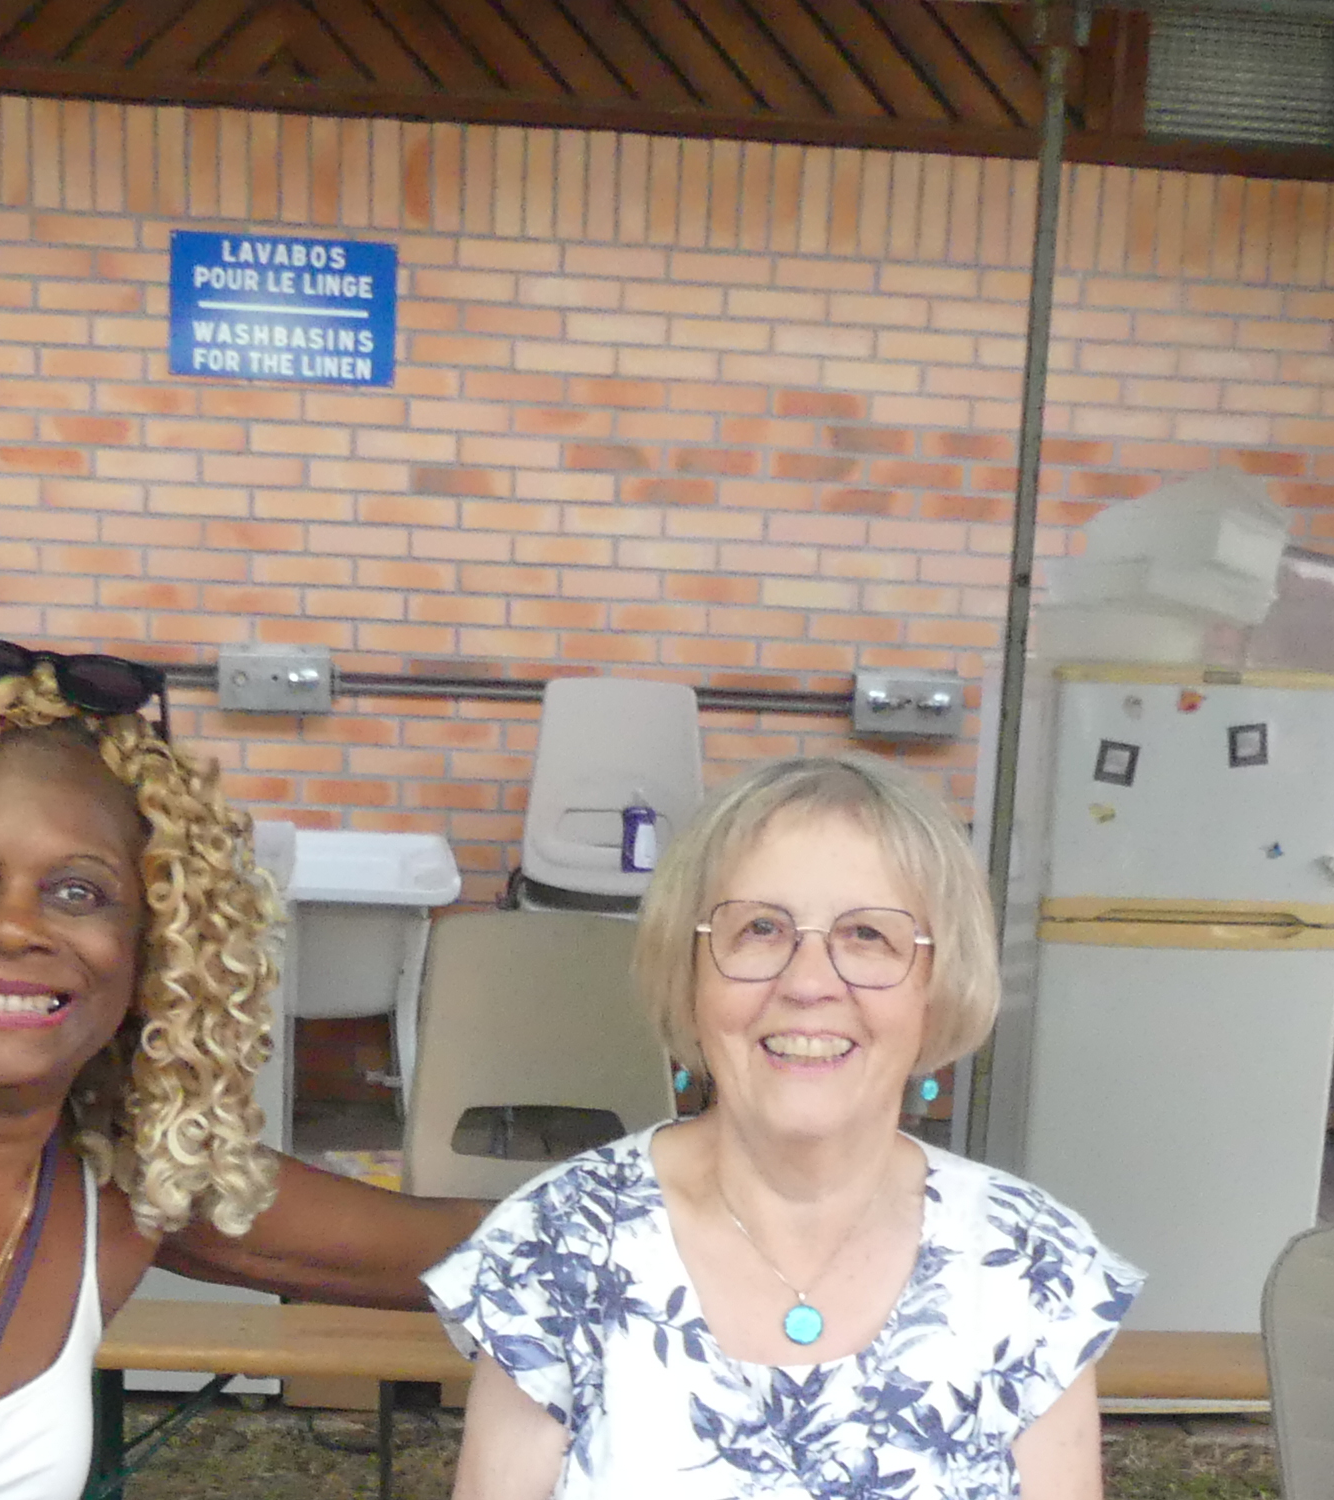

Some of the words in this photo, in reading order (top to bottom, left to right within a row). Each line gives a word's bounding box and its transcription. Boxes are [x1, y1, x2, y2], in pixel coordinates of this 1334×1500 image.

[221, 240, 347, 270] LAVABOS
[193, 265, 259, 291] POUR
[268, 270, 295, 294] LE
[303, 272, 373, 299] LINGE
[192, 321, 374, 353] WASHBASINS
[192, 348, 240, 372] FOR
[250, 351, 294, 375] THE
[301, 355, 373, 380] LINEN
